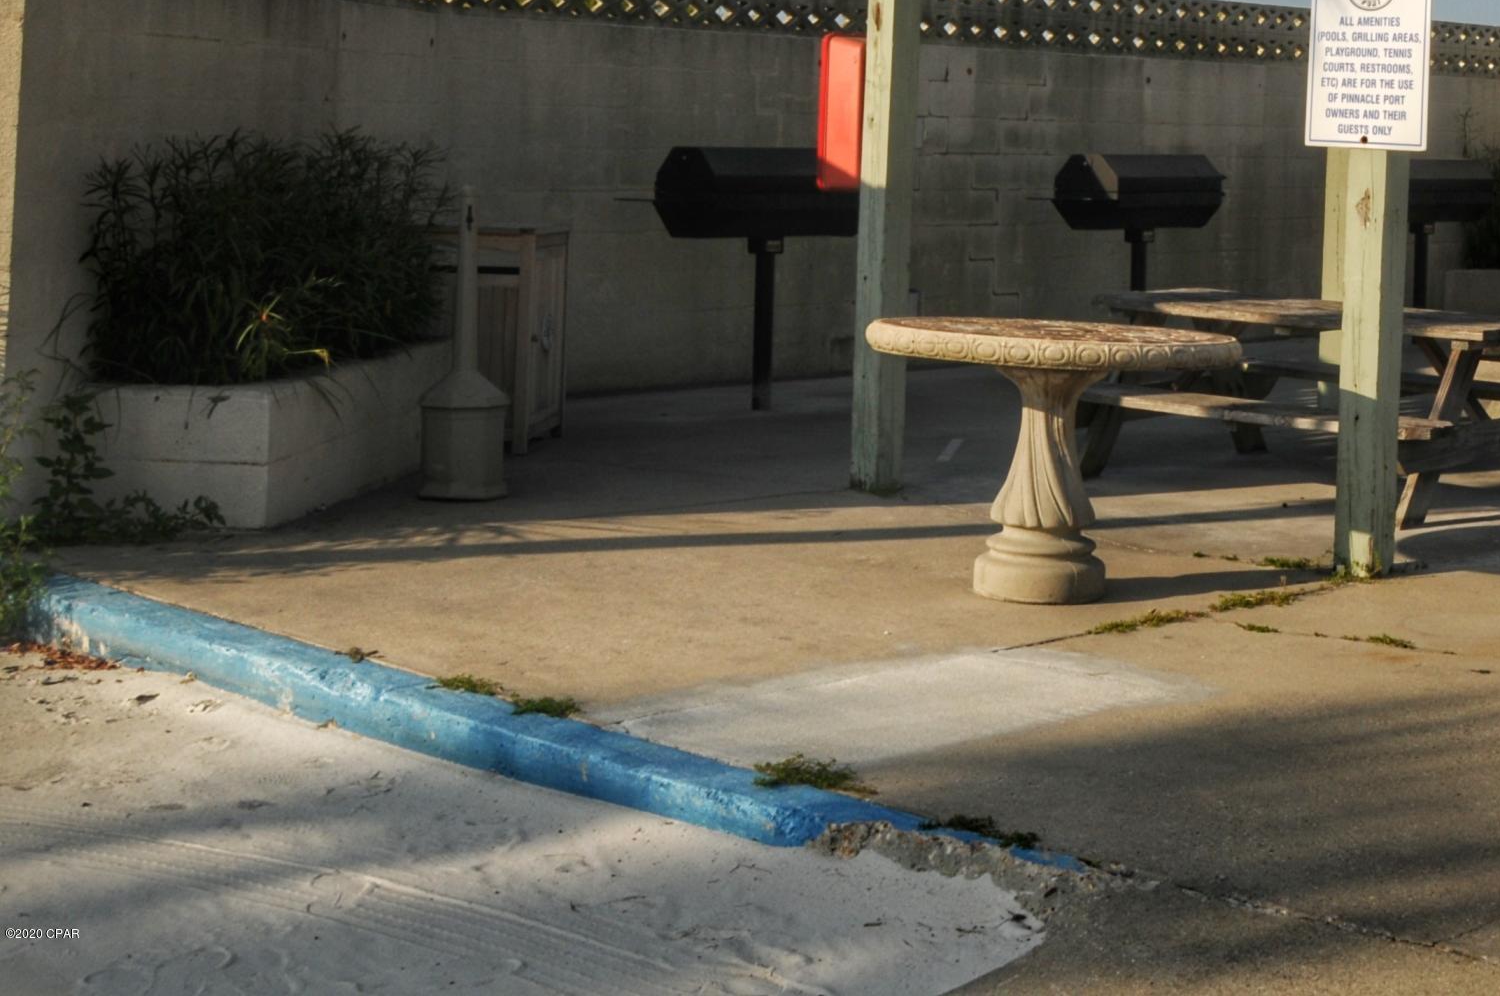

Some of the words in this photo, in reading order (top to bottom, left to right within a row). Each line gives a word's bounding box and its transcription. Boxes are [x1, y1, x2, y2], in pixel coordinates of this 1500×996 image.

[1339, 16, 1354, 27] ALL
[1357, 16, 1401, 27] AMENITIES
[1317, 31, 1349, 43] (POOLS,
[1352, 32, 1389, 43] GRILLING
[1392, 33, 1422, 44] AREAS,
[1325, 47, 1380, 58] PLAYGROUND,
[1383, 48, 1413, 58] TENNIS
[1323, 62, 1357, 73] COURTS,
[1360, 63, 1413, 75] RESTROOMS,
[1320, 77, 1338, 89] ETC)
[1341, 78, 1357, 88] ARE
[1360, 78, 1376, 89] FOR
[1380, 79, 1395, 89] THE
[1398, 79, 1414, 90] USE
[1328, 92, 1338, 103] OF
[1341, 93, 1380, 104] PINNACLE
[1383, 95, 1405, 105] PORT
[1325, 108, 1360, 119] OWNERS
[1362, 109, 1380, 120] AND
[1383, 110, 1407, 121] THEIR
[1337, 124, 1369, 135] GUESTS
[1372, 125, 1392, 135] ONLY
